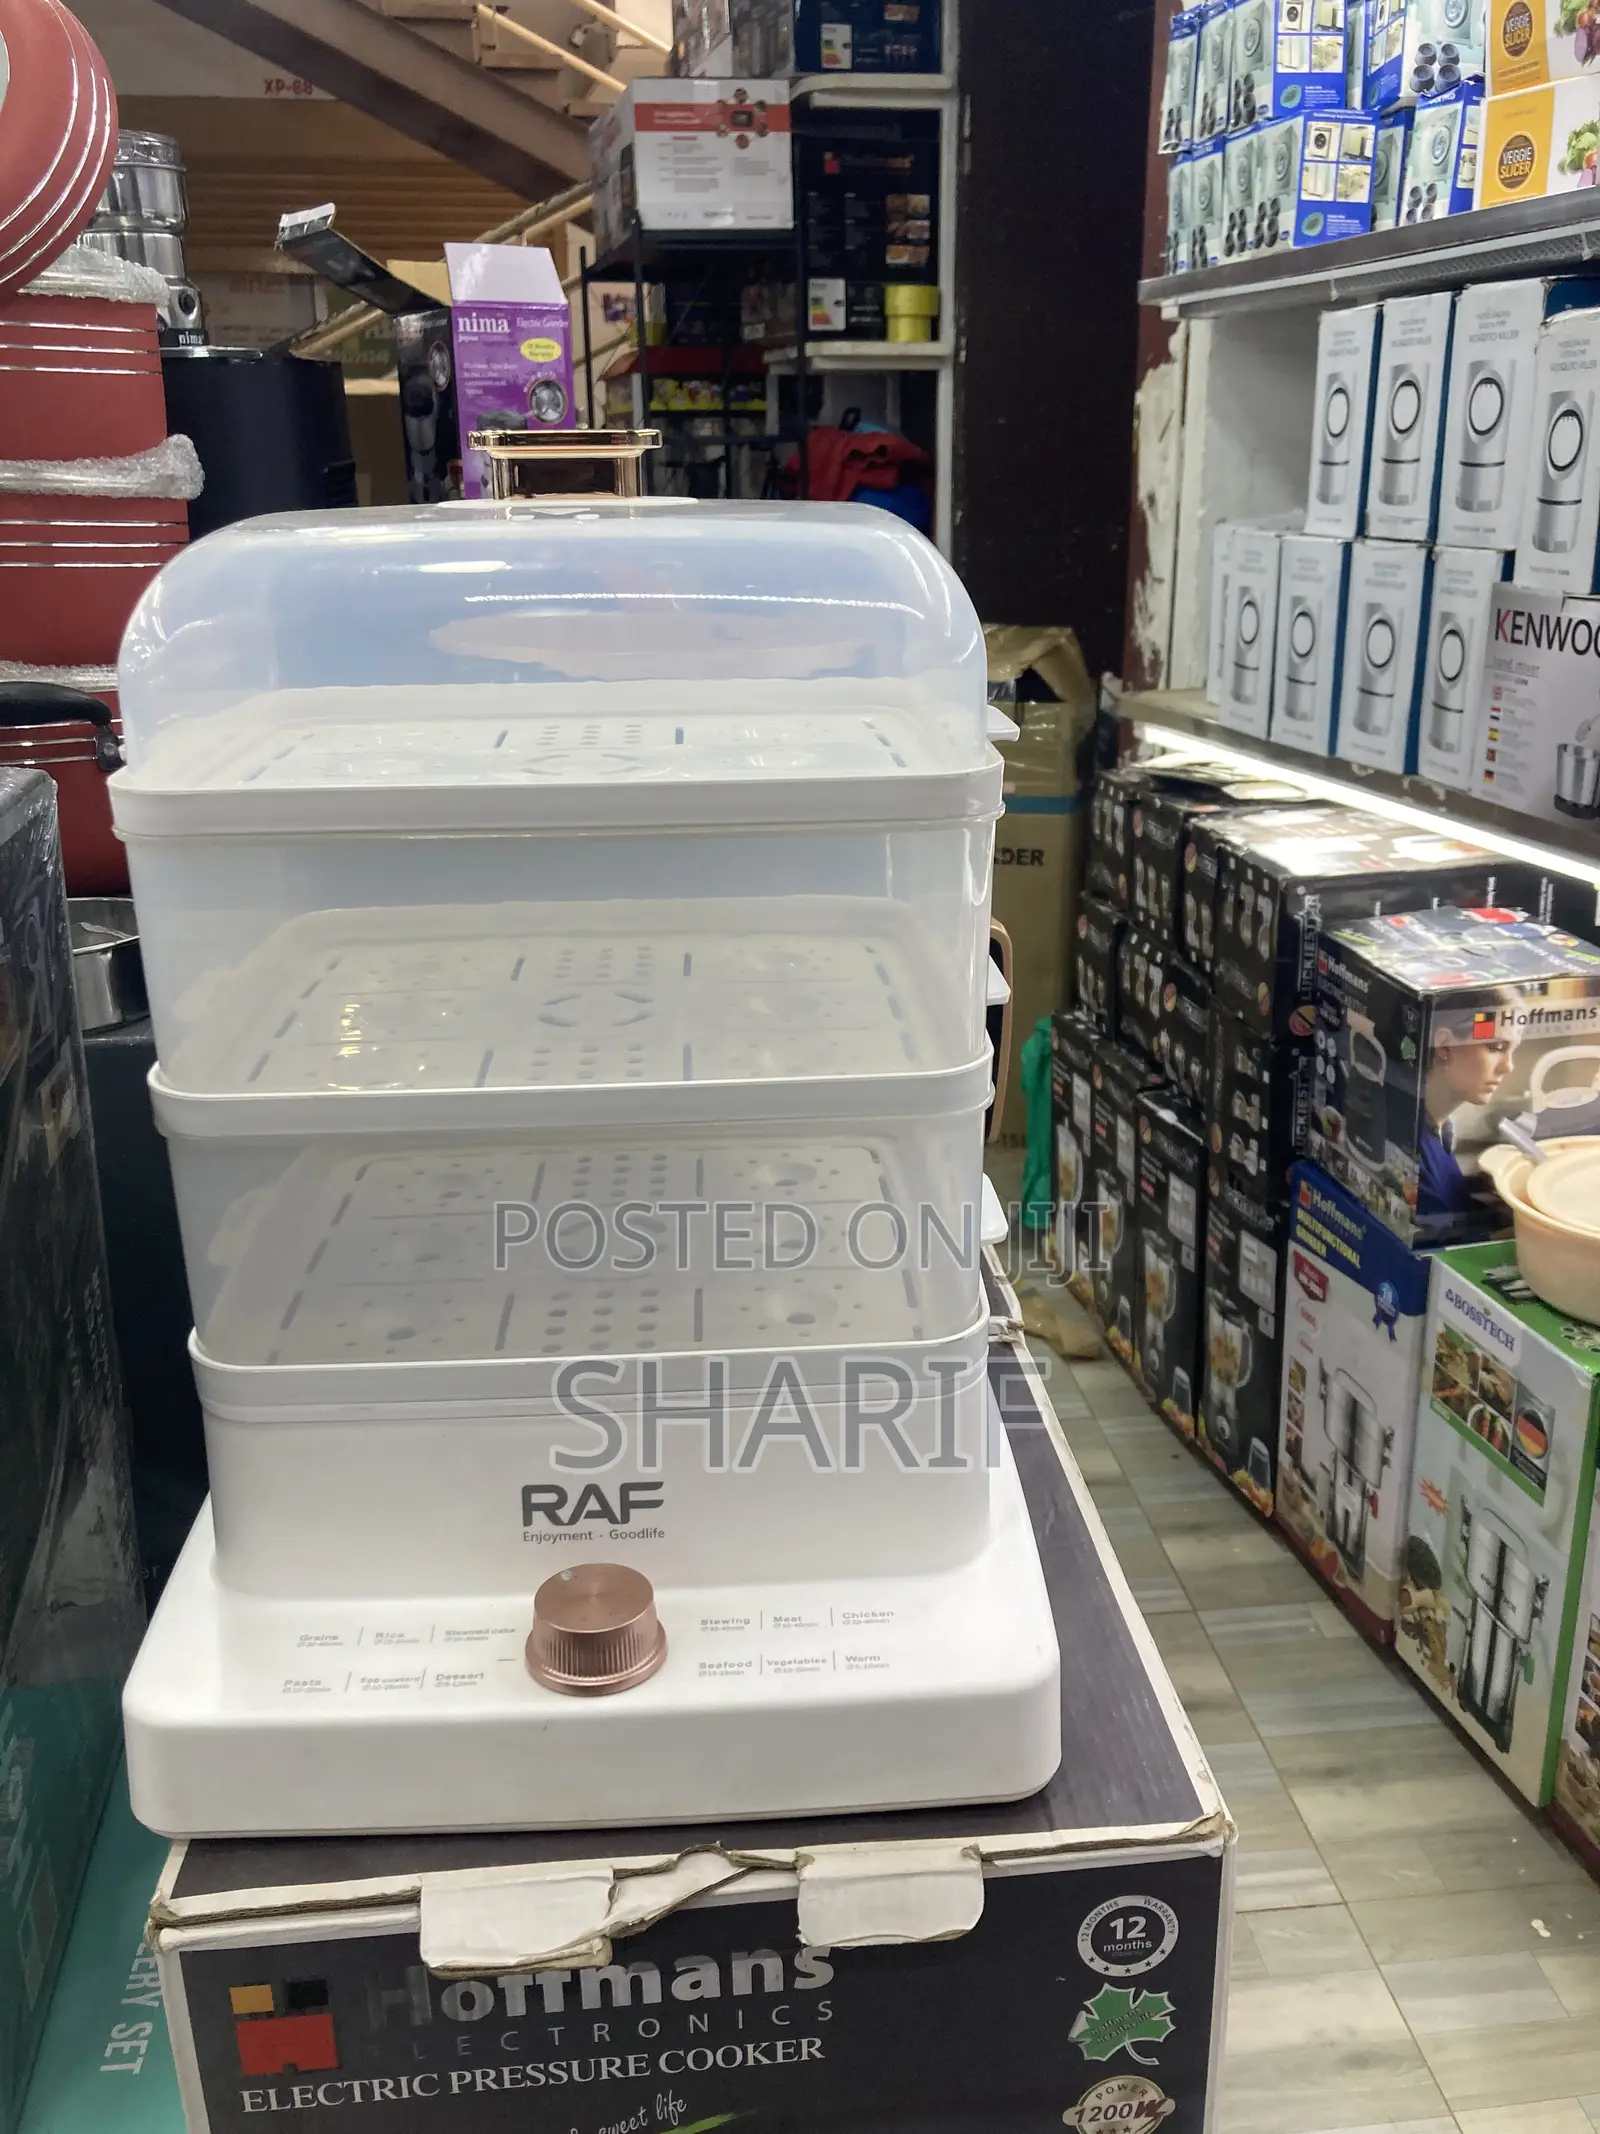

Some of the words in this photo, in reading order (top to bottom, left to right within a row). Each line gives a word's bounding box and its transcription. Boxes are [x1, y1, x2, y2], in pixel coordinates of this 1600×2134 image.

[1505, 12, 1532, 34] VEGGIE
[1505, 29, 1532, 48] SLICER
[1503, 146, 1533, 165] VEGGIE
[1500, 161, 1532, 180] SLICER
[457, 312, 511, 333] nima
[993, 847, 1045, 867] DER
[1500, 1007, 1598, 1027] Hoffmans
[521, 1481, 665, 1527] RAF
[523, 1530, 593, 1544] Enjoyment
[609, 1527, 665, 1540] Goodlife
[700, 1618, 751, 1626] Stewing
[842, 1611, 894, 1620] Chicken
[699, 1661, 753, 1669] Seafood
[767, 1657, 827, 1667] Vegetables
[845, 1655, 881, 1663] Warm
[436, 1672, 484, 1681] Dessert
[1084, 1900, 1120, 1931] MONTHS
[1143, 1898, 1176, 1935] WARRANTY
[1109, 1915, 1147, 1940] 12
[1103, 1940, 1153, 1952] months
[100, 2021, 153, 2075] SET
[240, 2072, 442, 2114] ELECTRIC
[448, 2053, 651, 2095] PRESSURE
[658, 2037, 826, 2074] COOKER
[1096, 2083, 1149, 2100] POWER
[656, 2089, 688, 2127] life
[1075, 2099, 1169, 2123] 1200W
